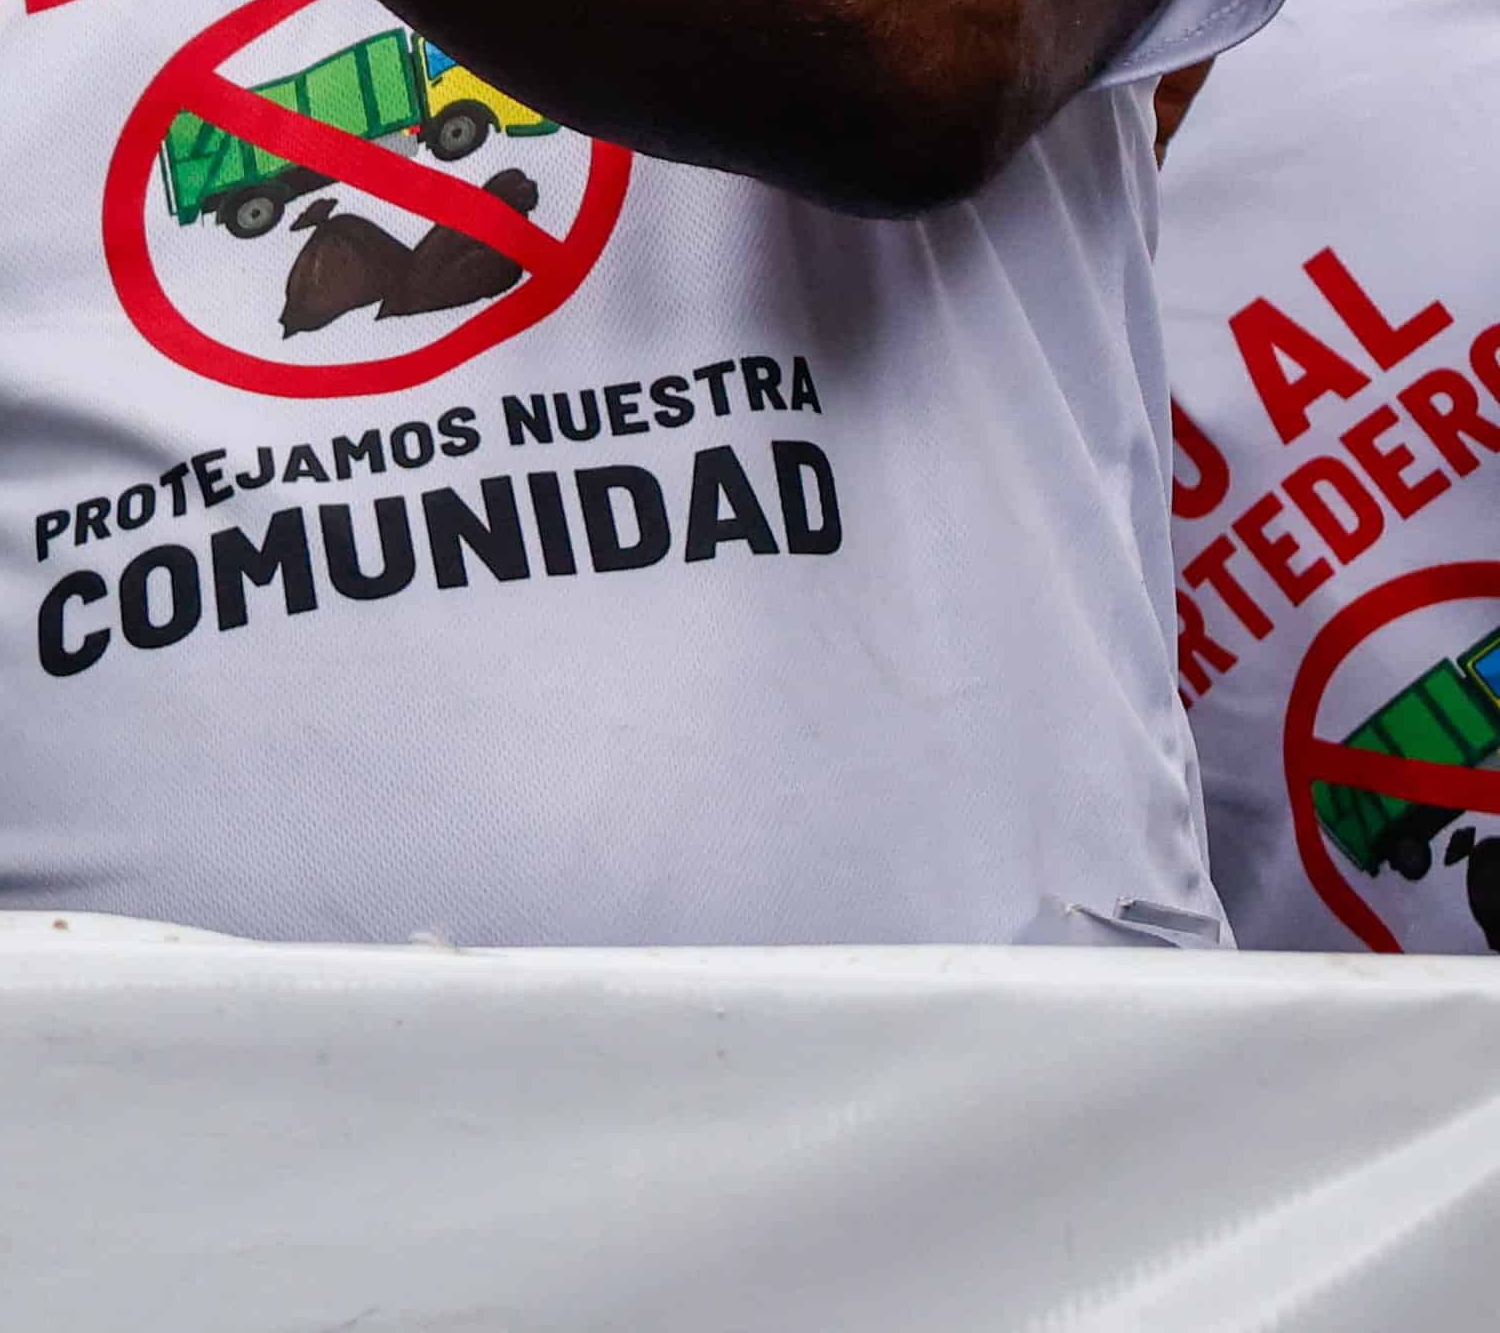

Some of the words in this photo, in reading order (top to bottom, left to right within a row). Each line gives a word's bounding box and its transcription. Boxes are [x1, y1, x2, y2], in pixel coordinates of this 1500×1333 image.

[1228, 245, 1455, 446] AL
[35, 406, 481, 562] PROTEJAMOS
[502, 355, 822, 446] NUESTRA
[37, 439, 842, 677] COMUNIDAD
